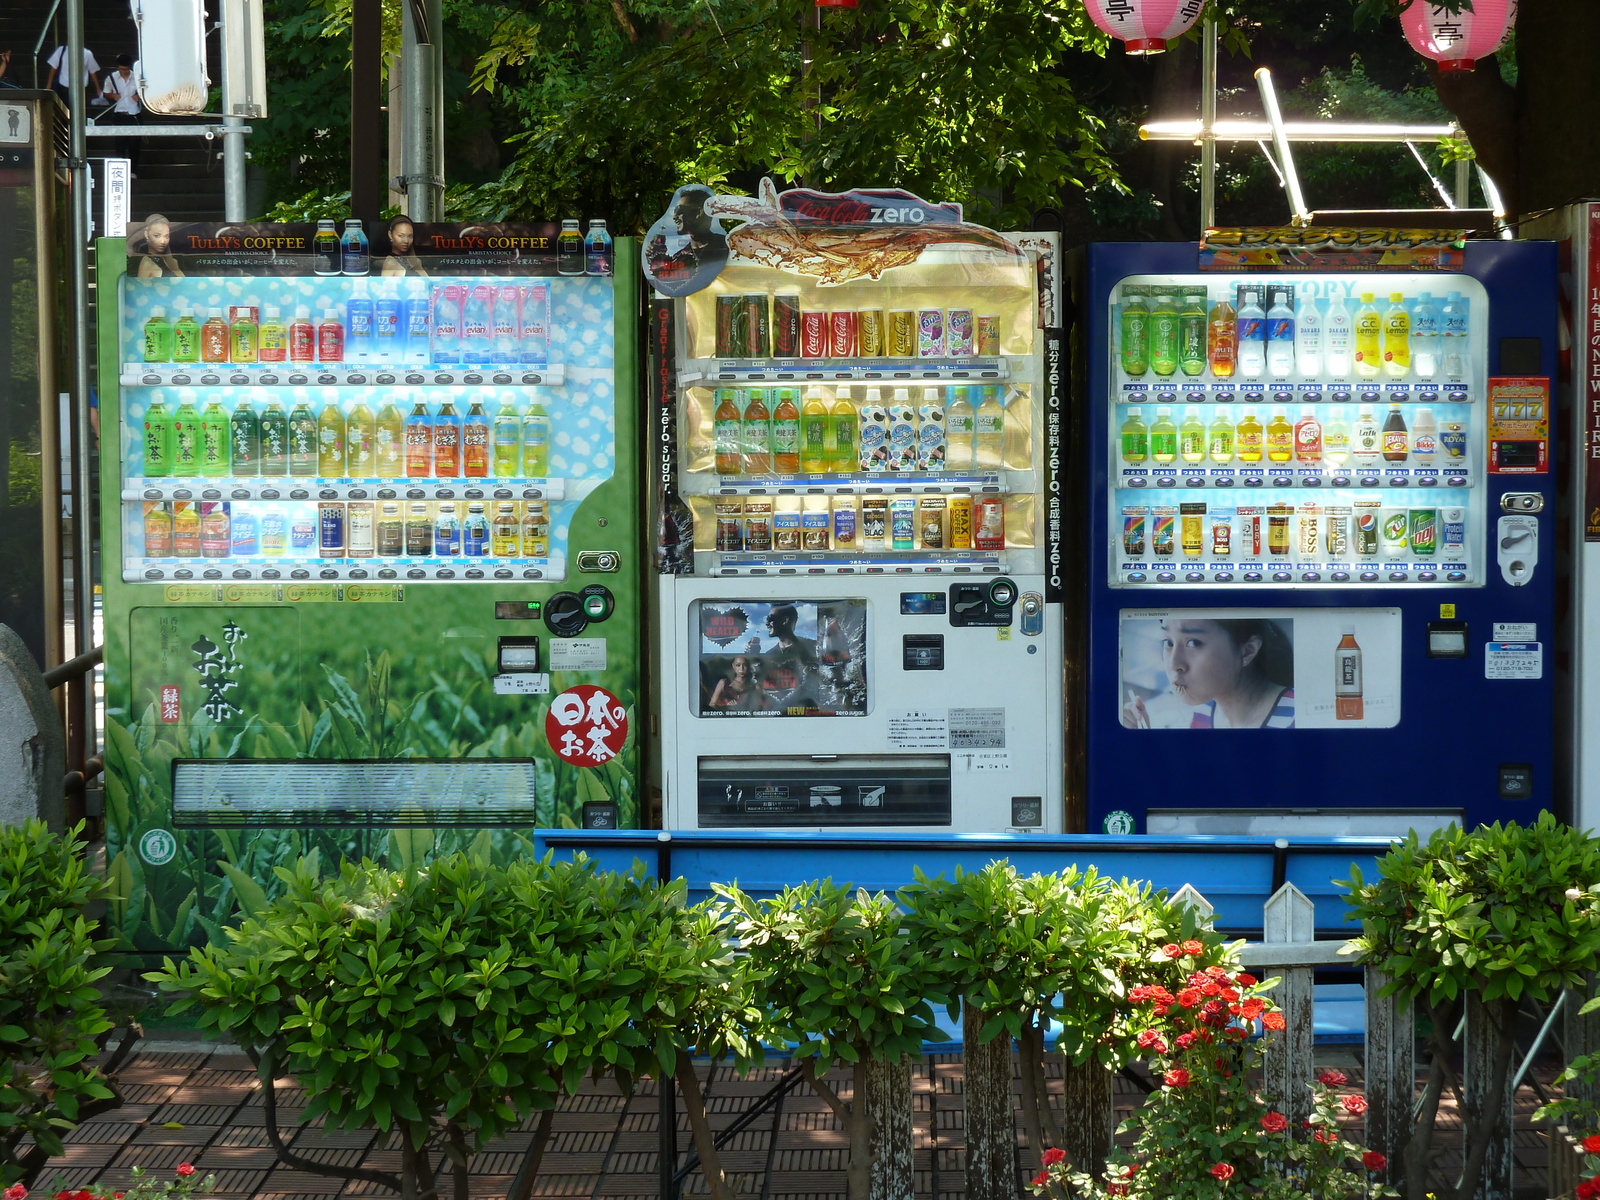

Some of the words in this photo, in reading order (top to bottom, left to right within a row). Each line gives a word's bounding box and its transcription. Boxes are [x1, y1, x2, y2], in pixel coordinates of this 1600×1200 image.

[795, 201, 872, 226] Coca-Cola
[870, 207, 925, 223] zero
[243, 237, 305, 249] COFFEE
[487, 237, 549, 249] COFFEE
[921, 314, 940, 328] Fanta
[952, 314, 970, 328] Fanta
[437, 325, 456, 334] evian
[495, 326, 514, 334] evian
[525, 326, 543, 334] evian
[658, 308, 669, 354] Great
[806, 316, 819, 355] Coca-Cola
[834, 316, 847, 354] Coca-Cola
[864, 316, 874, 354] Coca-Cola
[895, 316, 906, 354] Coca-Cola
[661, 407, 669, 441] zero
[406, 434, 428, 446] むぎ茶
[435, 434, 456, 446] むぎ茶
[464, 434, 486, 446] むぎ茶
[662, 445, 671, 494] sugar.
[1444, 524, 1463, 533] Protein
[1308, 519, 1317, 554] BOSS
[1336, 519, 1346, 553] BLACK
[1446, 532, 1463, 542] Water
[710, 616, 734, 626] WILD
[706, 626, 740, 636] HEALTH
[162, 688, 178, 718] 緑茶
[551, 690, 626, 729] 日本の
[787, 706, 805, 716] NEW
[560, 724, 616, 762] お茶
